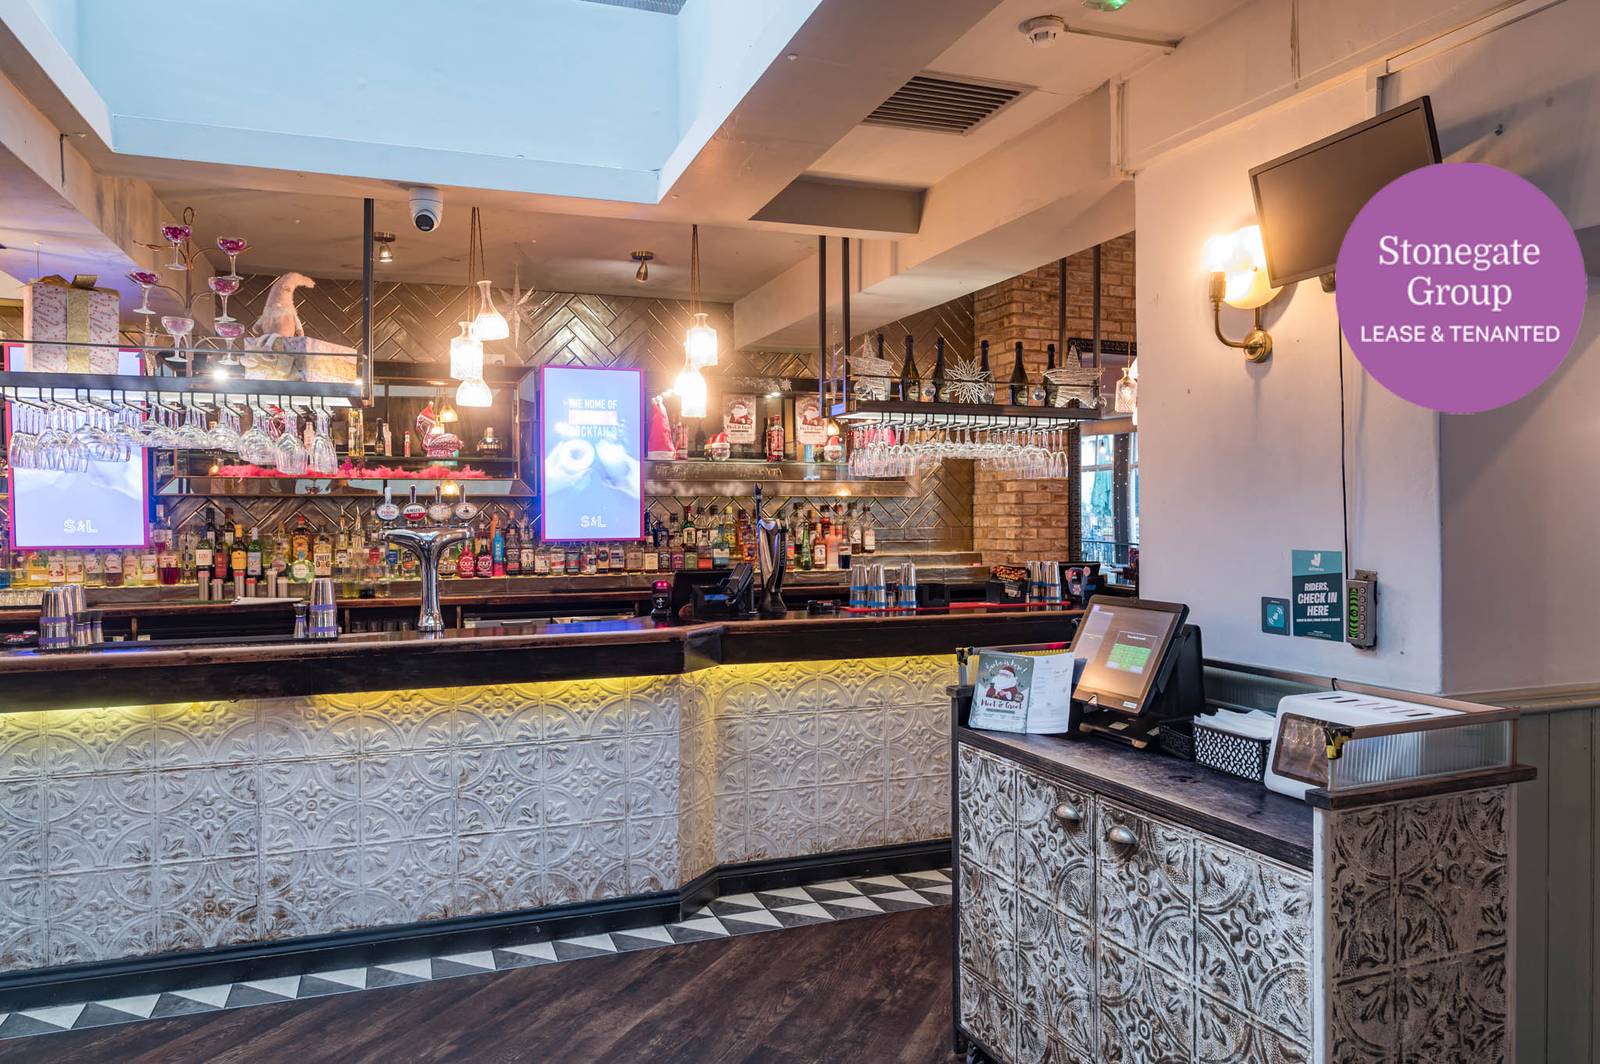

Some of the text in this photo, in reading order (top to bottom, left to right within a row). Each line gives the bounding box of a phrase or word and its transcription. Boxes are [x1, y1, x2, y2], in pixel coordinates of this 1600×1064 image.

[584, 399, 606, 410] HOME
[607, 400, 618, 410] OF
[1304, 582, 1329, 592] RIDERS,
[1297, 592, 1338, 605] CHECK IN
[1307, 604, 1330, 617] HERE
